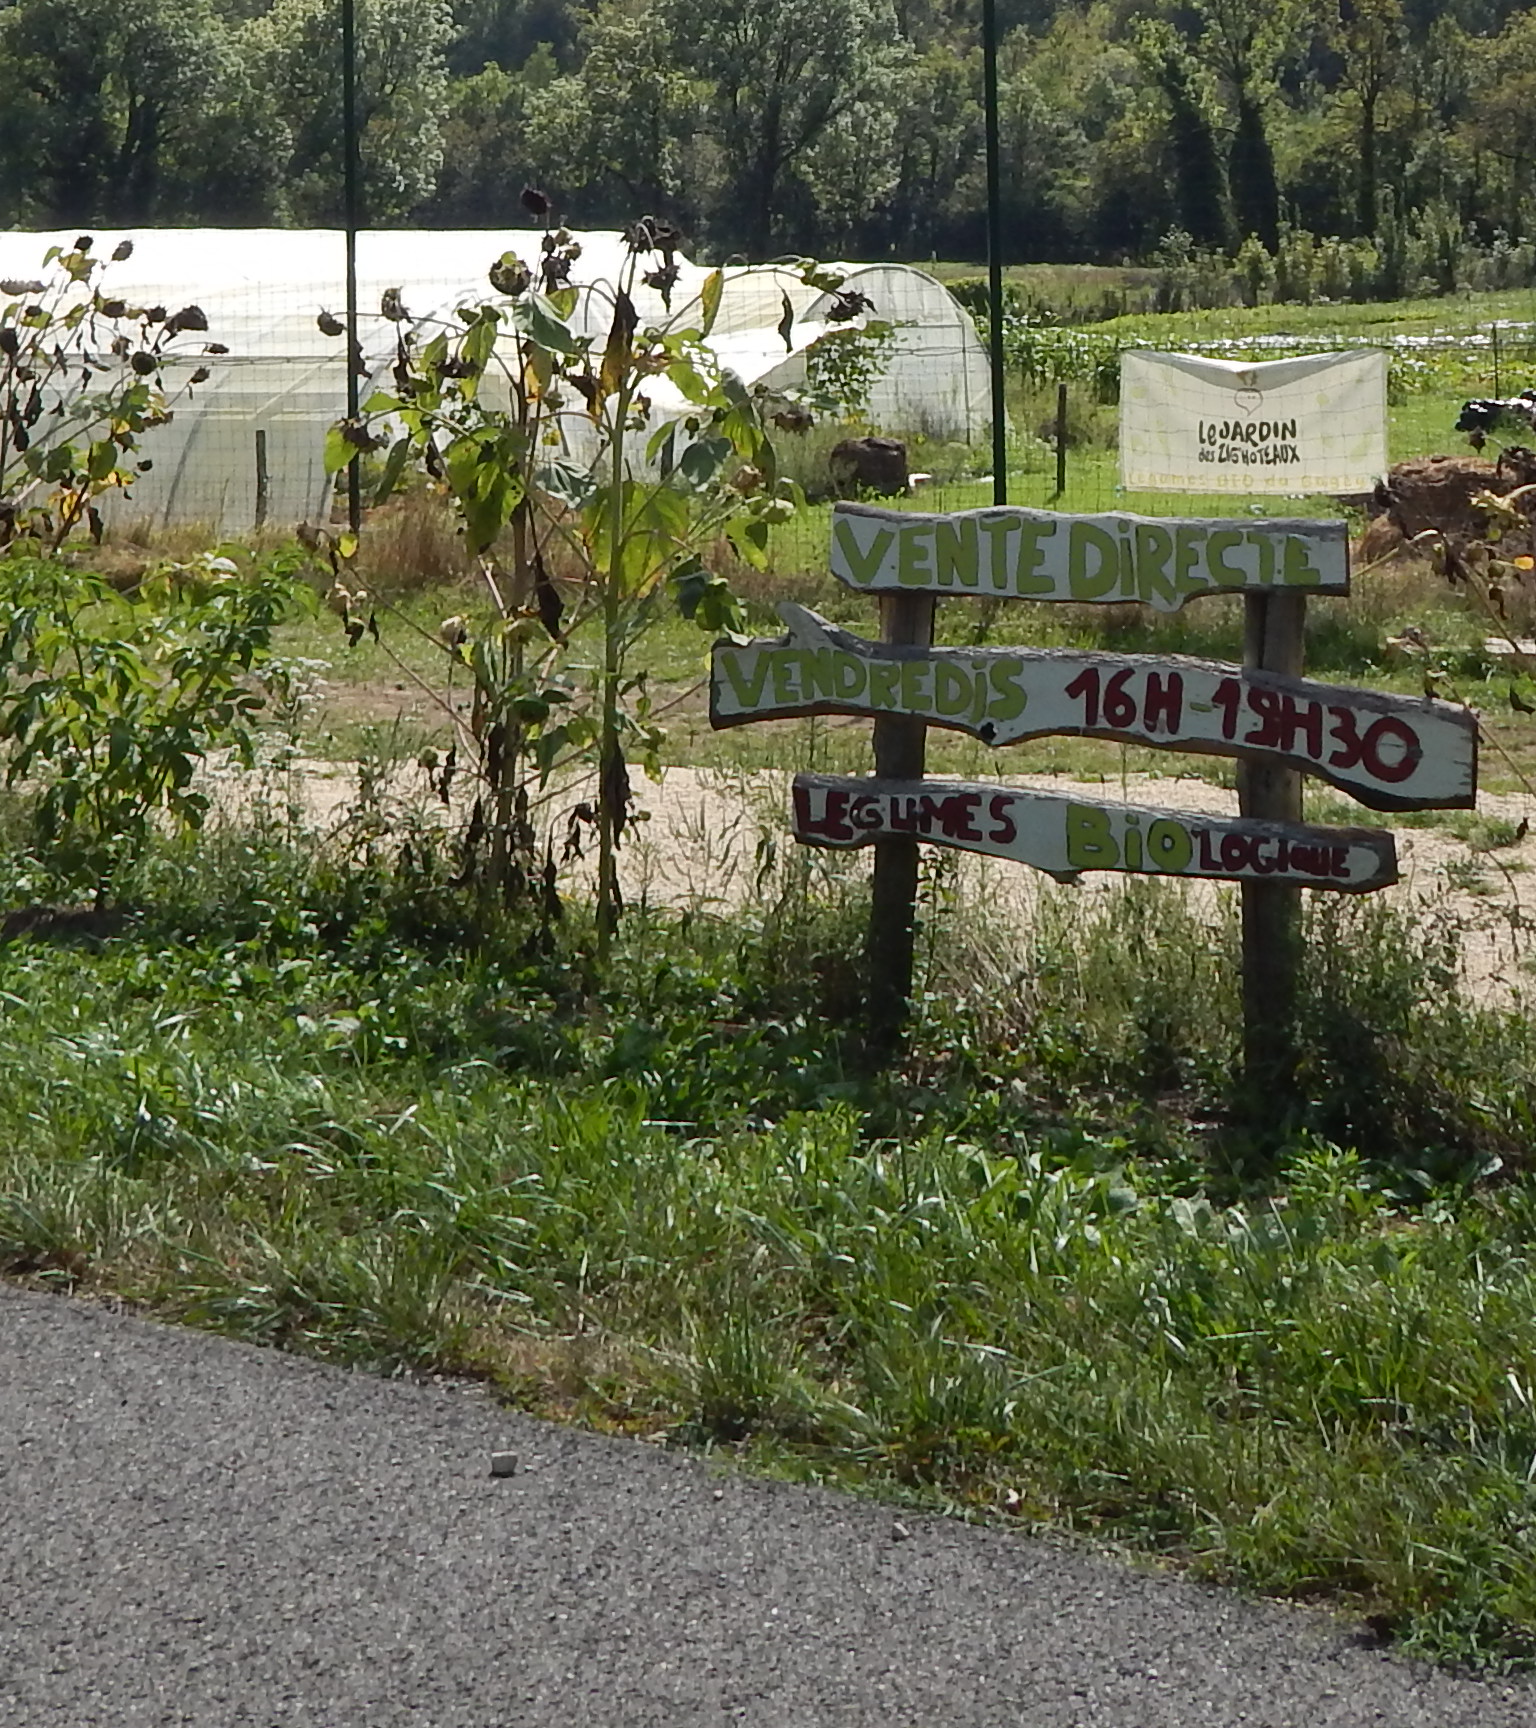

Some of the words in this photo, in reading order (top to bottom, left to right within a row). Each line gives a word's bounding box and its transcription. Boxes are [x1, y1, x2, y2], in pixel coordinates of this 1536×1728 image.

[1198, 419, 1217, 446] Le
[1219, 418, 1297, 447] JARDIN
[1198, 447, 1216, 463] des
[835, 517, 1057, 594] VENTE
[793, 785, 1018, 844] LEGUMES
